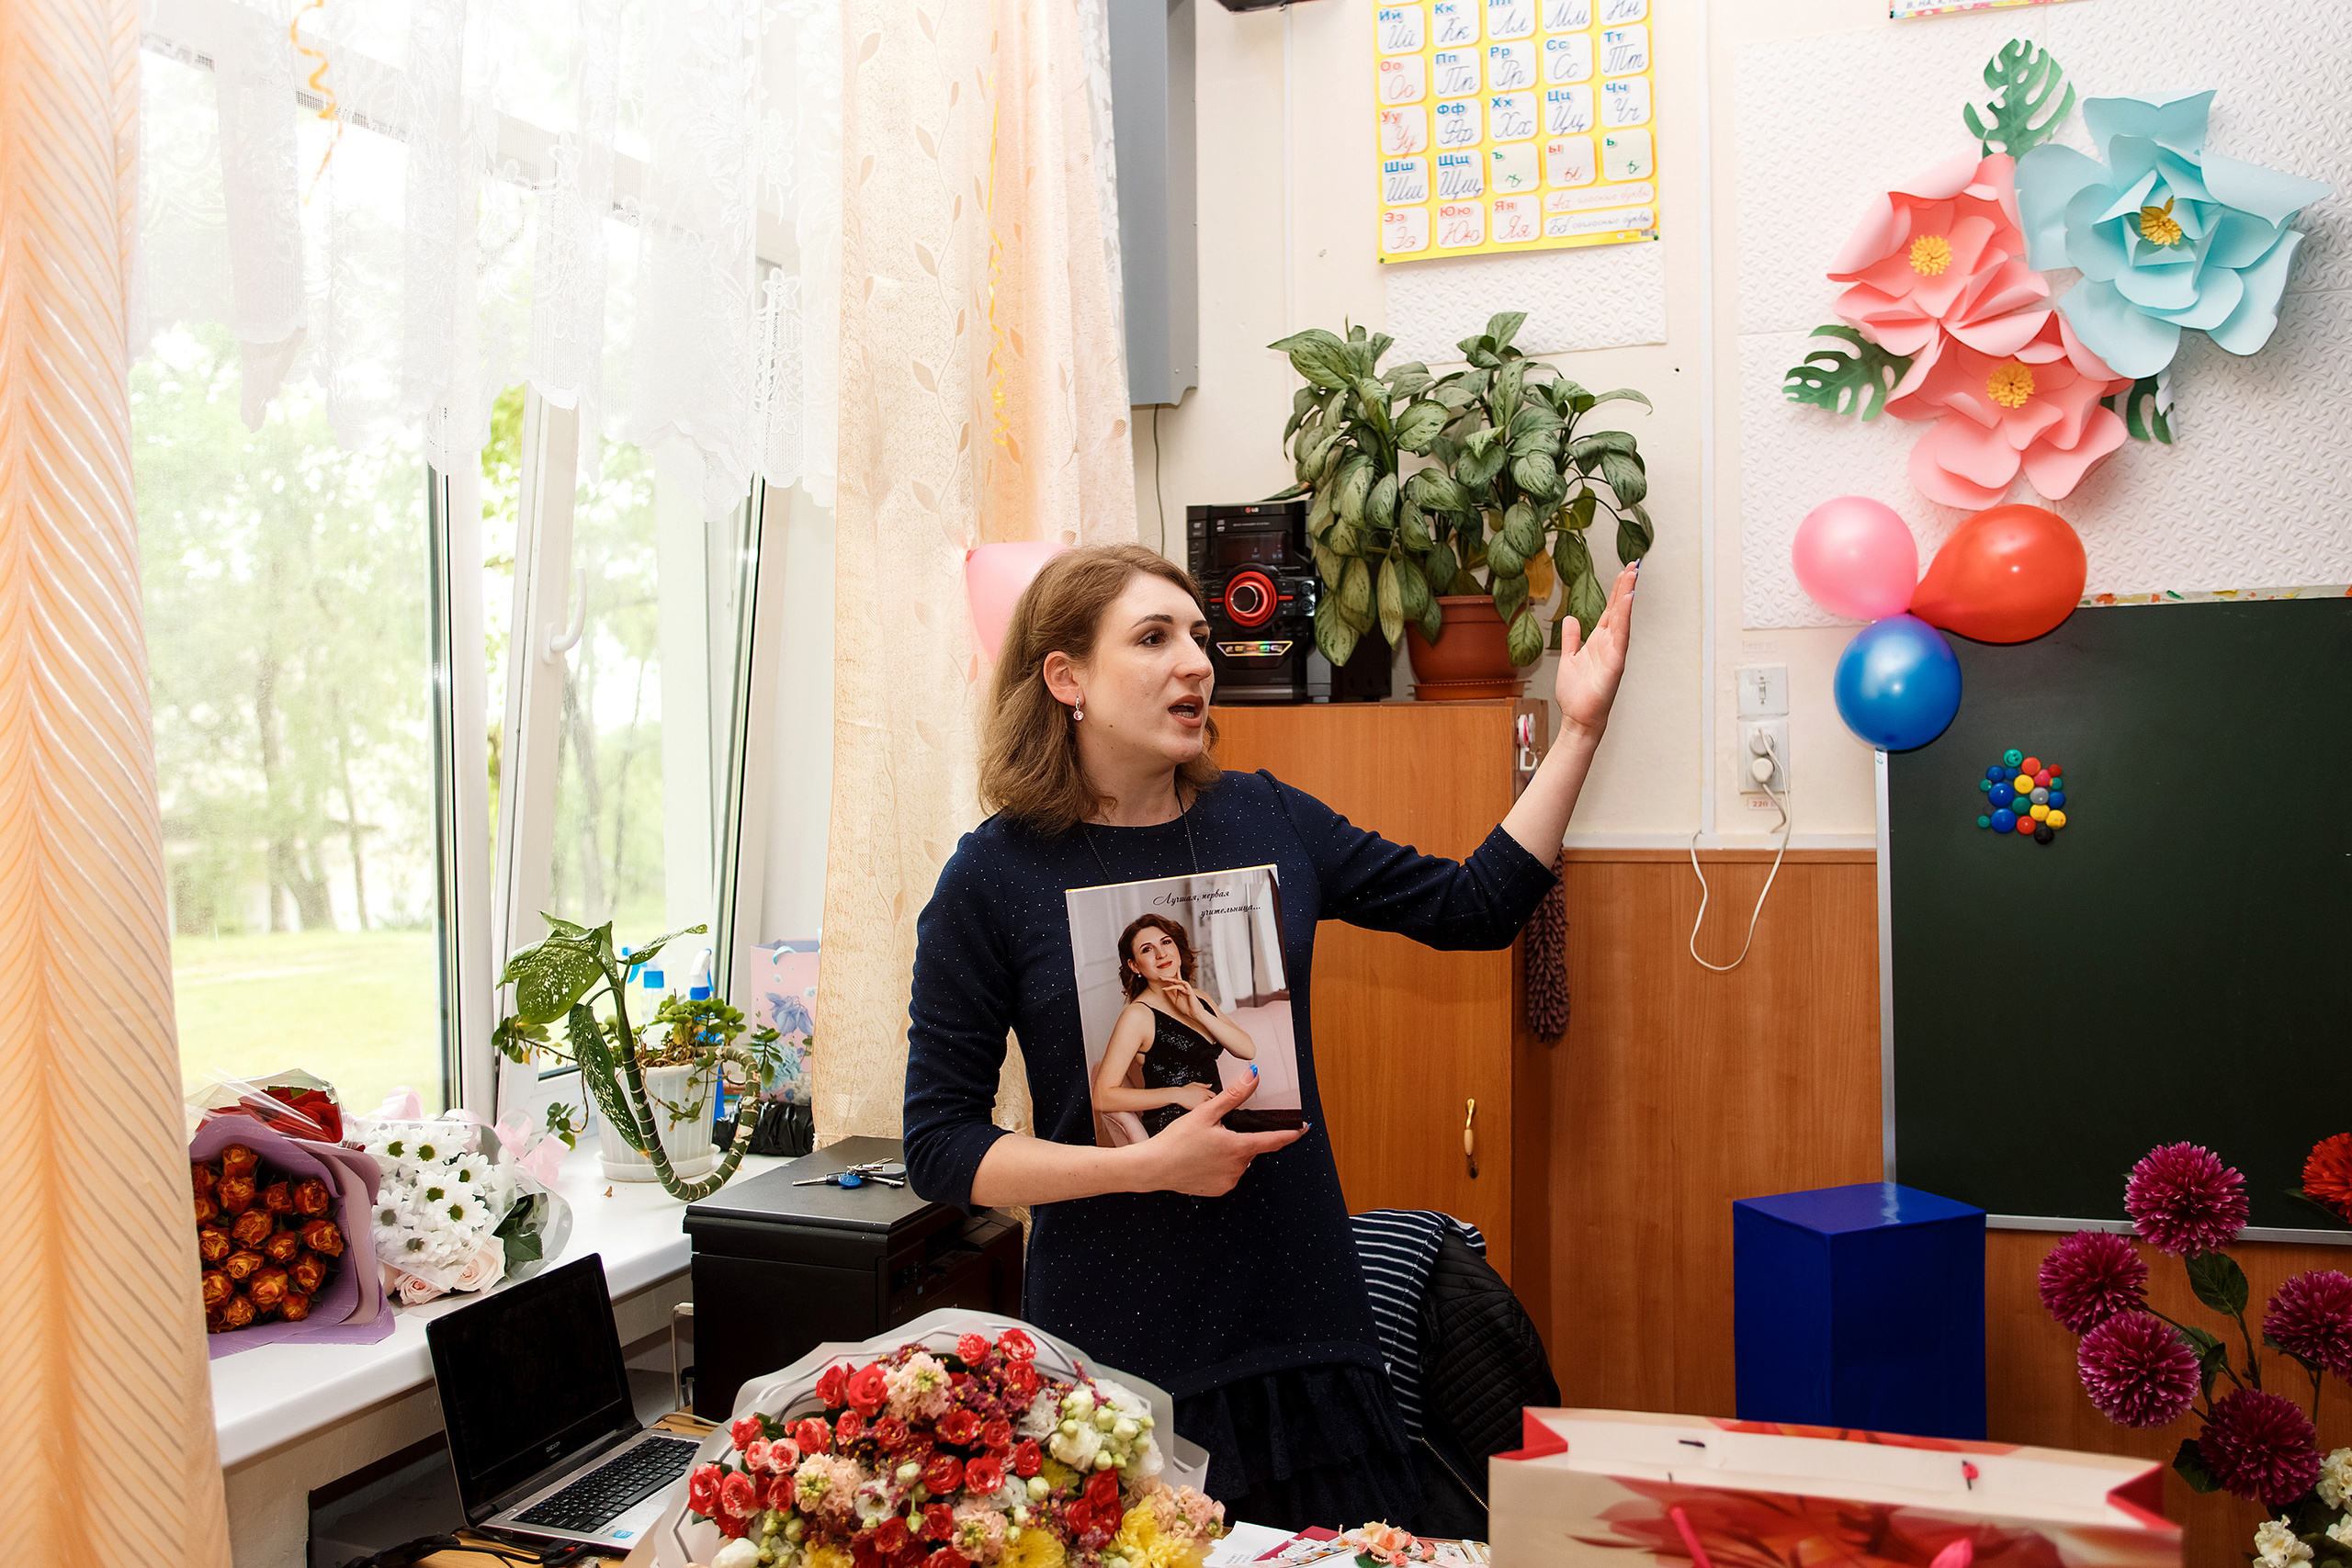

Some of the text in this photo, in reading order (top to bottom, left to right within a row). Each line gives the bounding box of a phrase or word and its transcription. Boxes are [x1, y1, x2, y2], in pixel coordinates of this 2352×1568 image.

[1379, 8, 1402, 21] Йй
[1434, 4, 1453, 14] Кк
[1603, 31, 1623, 42] Тт
[1546, 39, 1567, 51] Сс
[1435, 53, 1457, 64] Пп
[1490, 46, 1510, 59] Рр
[1380, 61, 1401, 72] Оо
[1605, 83, 1627, 94] Чч
[1547, 90, 1571, 102] Цц
[1491, 97, 1512, 108] Хх
[1437, 103, 1464, 116] Фф
[1381, 111, 1400, 124] Уу
[1438, 154, 1469, 166] Щщ
[1384, 161, 1414, 173] Шш
[1440, 206, 1471, 217] Юю
[1494, 200, 1515, 212] Яя
[1384, 212, 1405, 222] Ээ
[1152, 888, 1230, 907] Лучшая, первая
